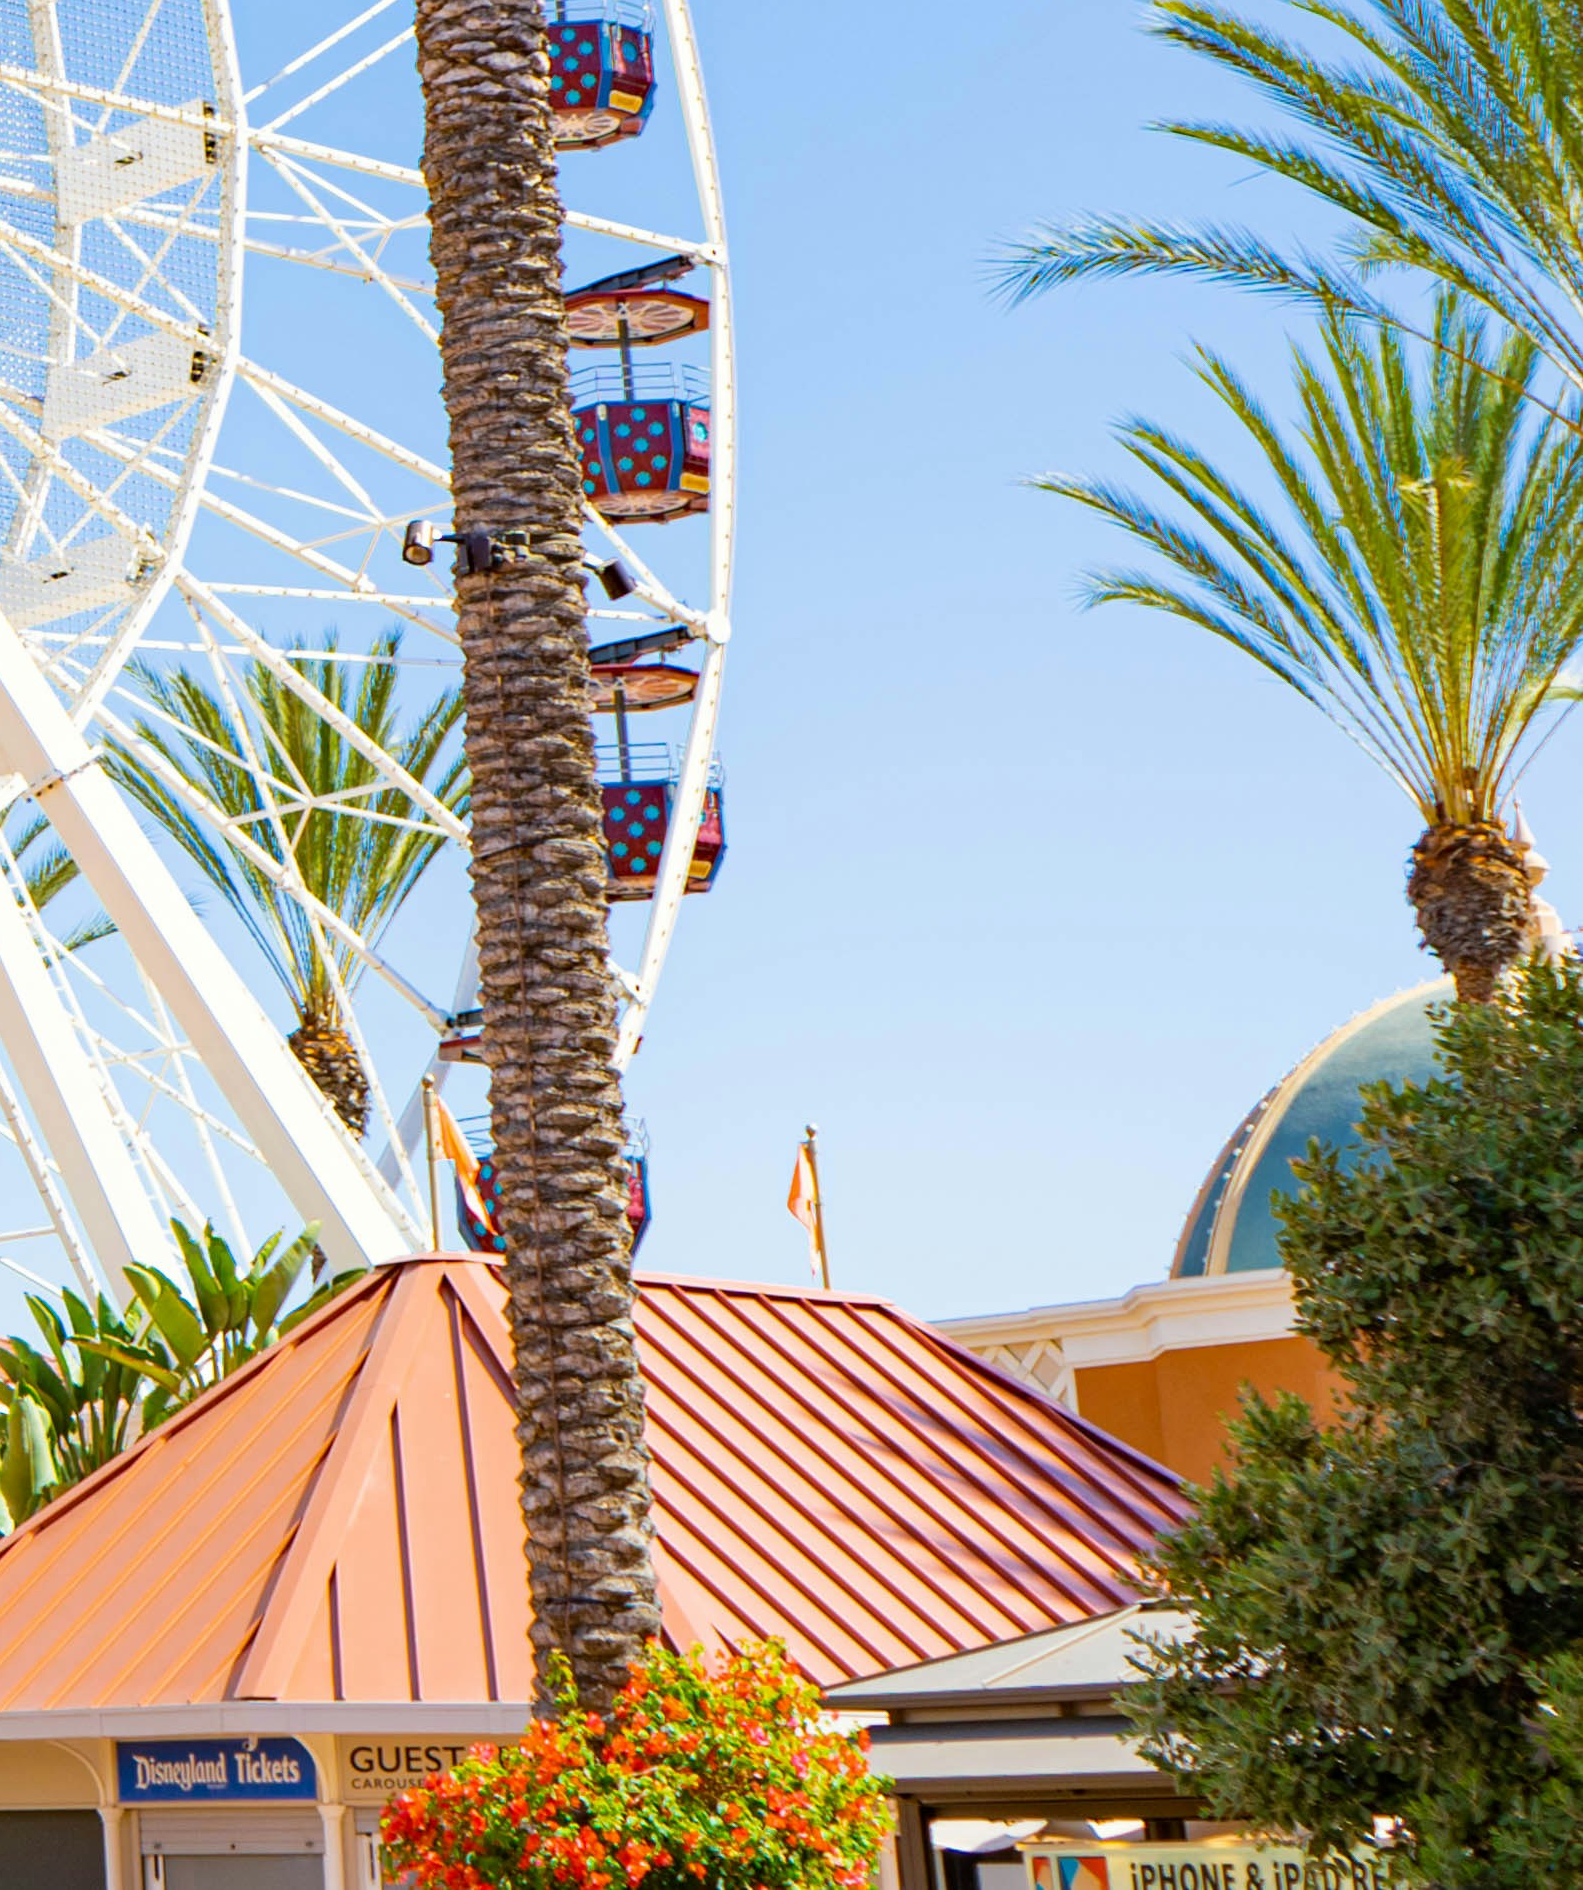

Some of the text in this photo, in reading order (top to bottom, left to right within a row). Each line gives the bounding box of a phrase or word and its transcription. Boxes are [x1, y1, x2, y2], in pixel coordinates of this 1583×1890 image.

[132, 1751, 301, 1792] Disneyland Tickets
[349, 1746, 465, 1773] GUEST
[351, 1778, 426, 1790] CAROUSE
[1129, 1862, 1235, 1890] iPHONE
[1246, 1862, 1265, 1890] &
